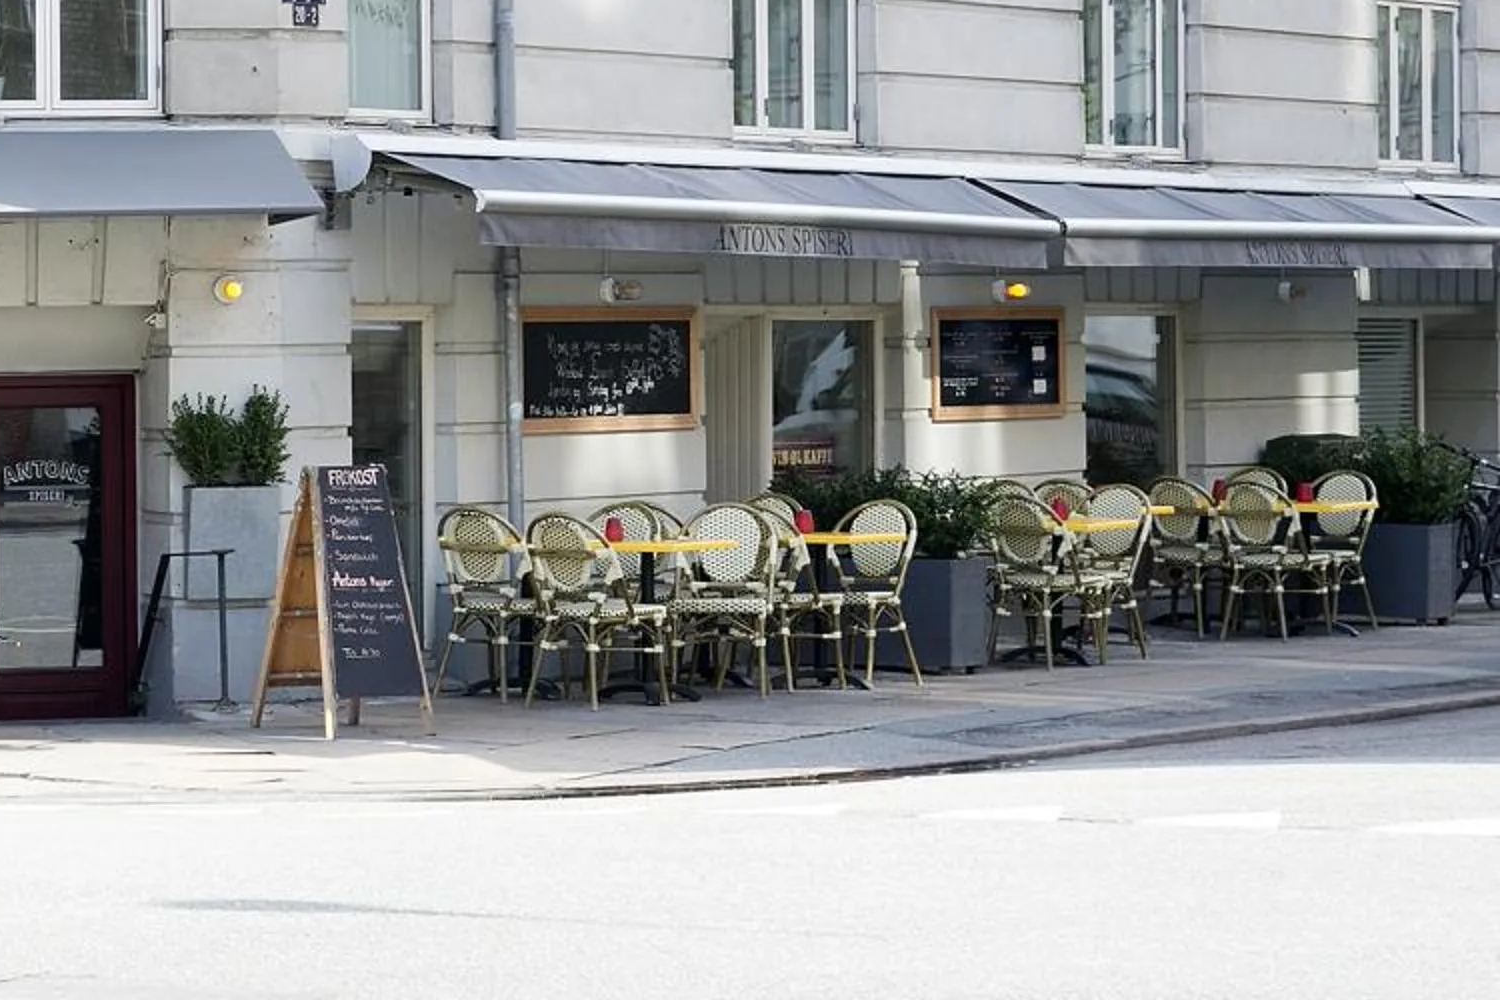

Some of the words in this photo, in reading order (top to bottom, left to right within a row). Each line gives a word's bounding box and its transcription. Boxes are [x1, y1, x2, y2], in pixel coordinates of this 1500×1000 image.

[713, 225, 786, 253] ANTONS
[791, 227, 853, 256] SPISERI
[3, 459, 91, 486] ANTONS
[29, 490, 65, 502] SPISERI
